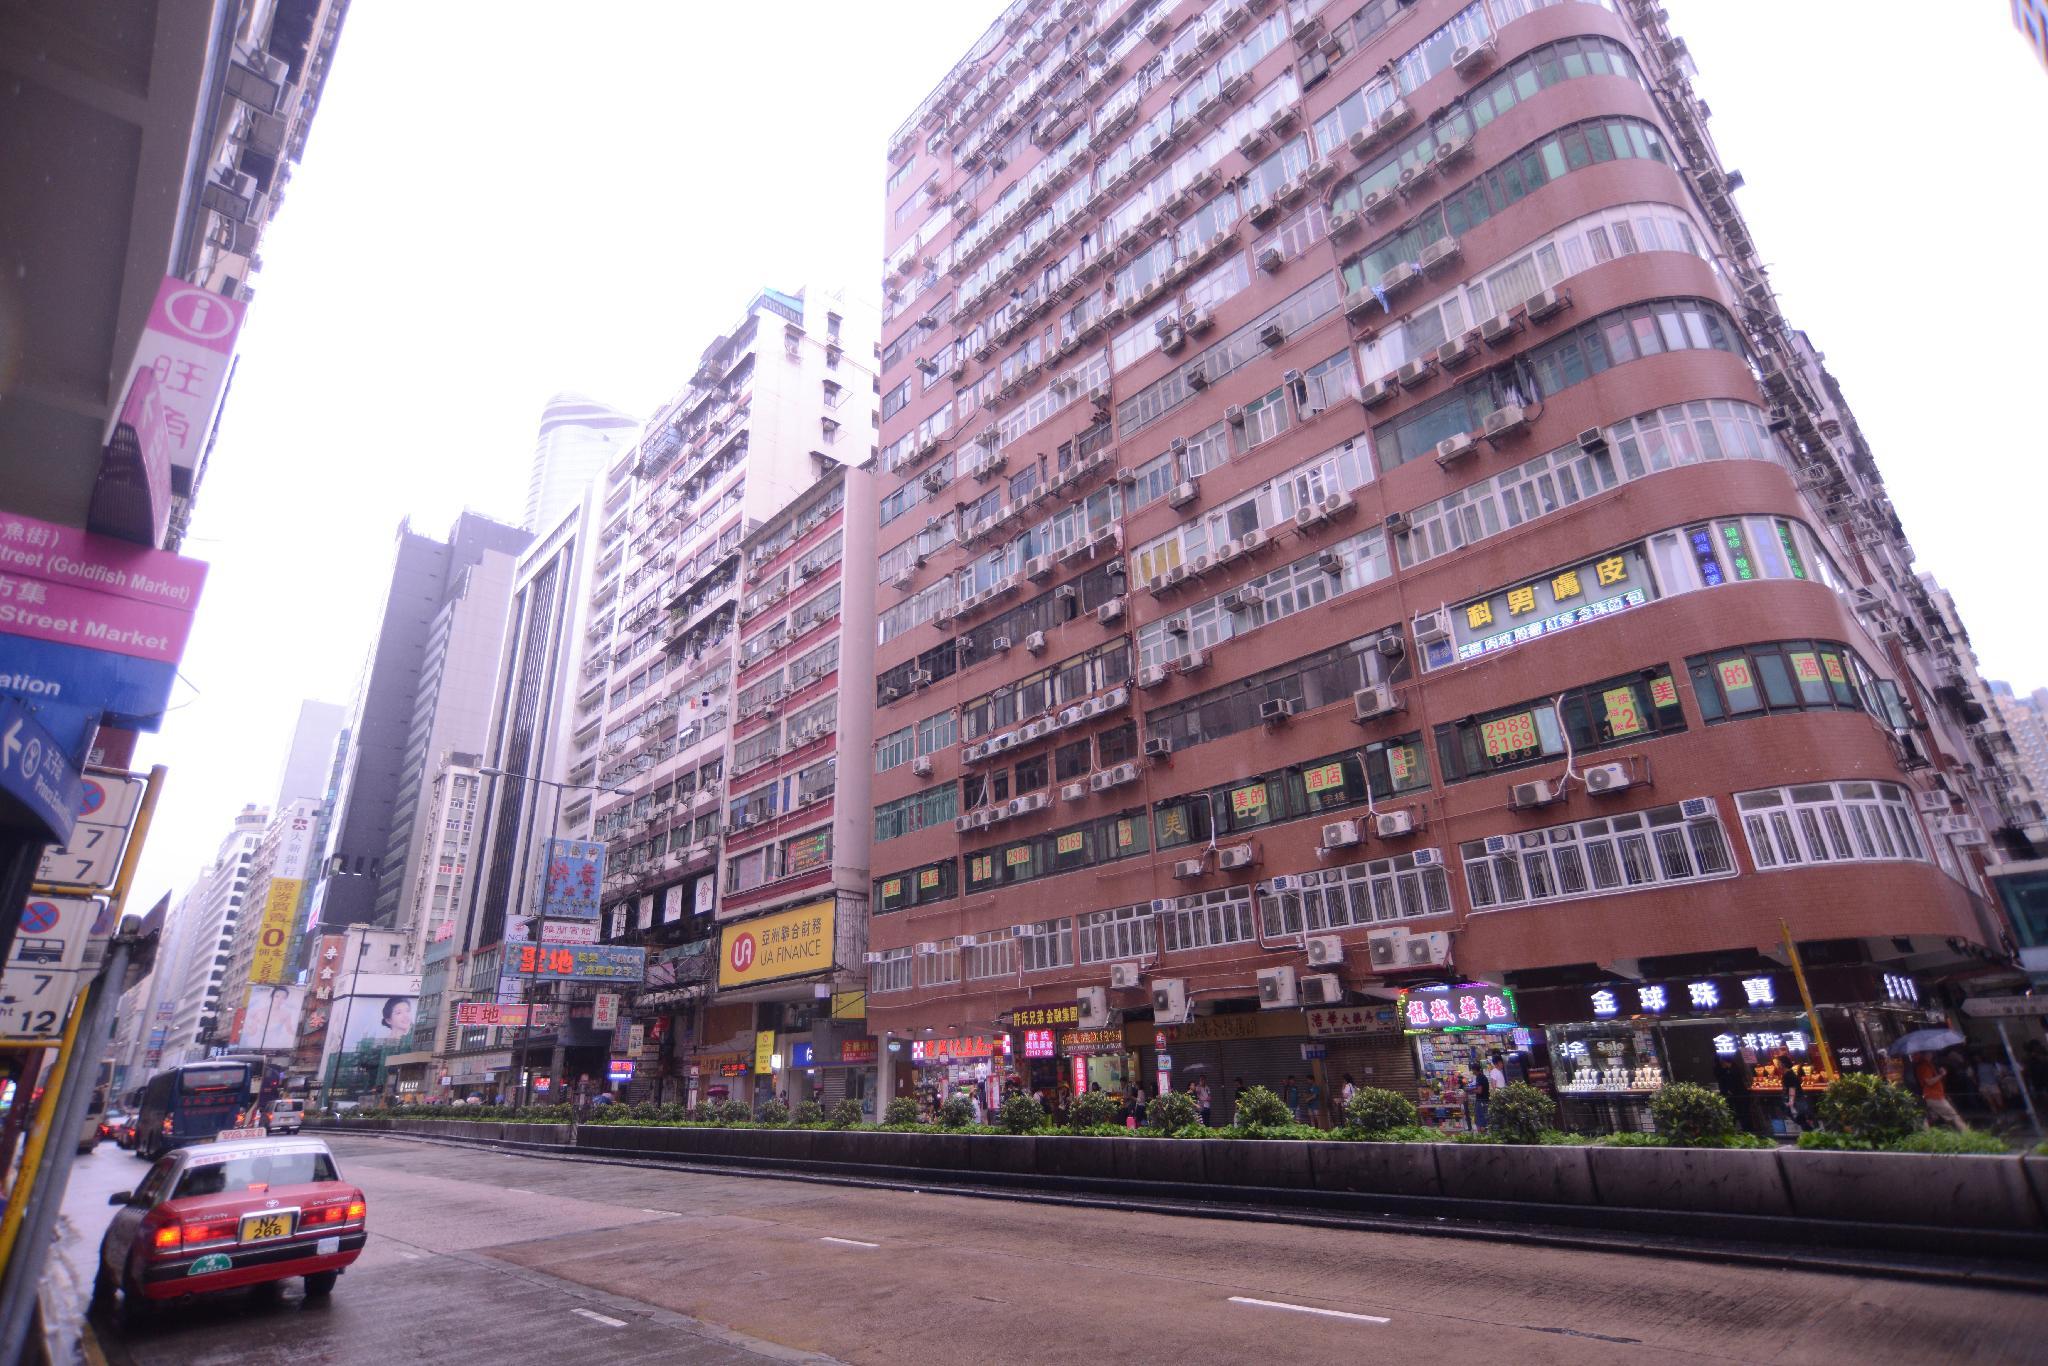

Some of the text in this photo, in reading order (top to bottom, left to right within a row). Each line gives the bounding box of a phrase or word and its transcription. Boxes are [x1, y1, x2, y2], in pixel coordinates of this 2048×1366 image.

[0, 521, 60, 548] 魚街)
[0, 546, 43, 568] treet
[131, 574, 191, 603] Market)
[85, 621, 168, 650] Market
[1651, 682, 1674, 704] 美
[1723, 664, 1748, 686] 的
[1798, 657, 1820, 677] 酒
[1486, 715, 1530, 739] 2988
[1489, 733, 1534, 754] 8169
[1233, 767, 1342, 810] 美的 酒店
[87, 829, 104, 848] 7
[1058, 833, 1081, 852] 8169
[75, 860, 93, 879] 7
[761, 917, 822, 945] 亞洲聯合財務
[760, 939, 821, 967] UA FINANCE
[33, 974, 53, 995] 7
[1591, 977, 1775, 1014] 金球珠寶
[20, 1010, 57, 1031] 12
[458, 1005, 499, 1023] 聖地
[1013, 1009, 1045, 1027] 許氏兄弟
[1596, 1041, 1625, 1052] Sale
[259, 1215, 278, 1228] NZ
[253, 1225, 282, 1240] 266
